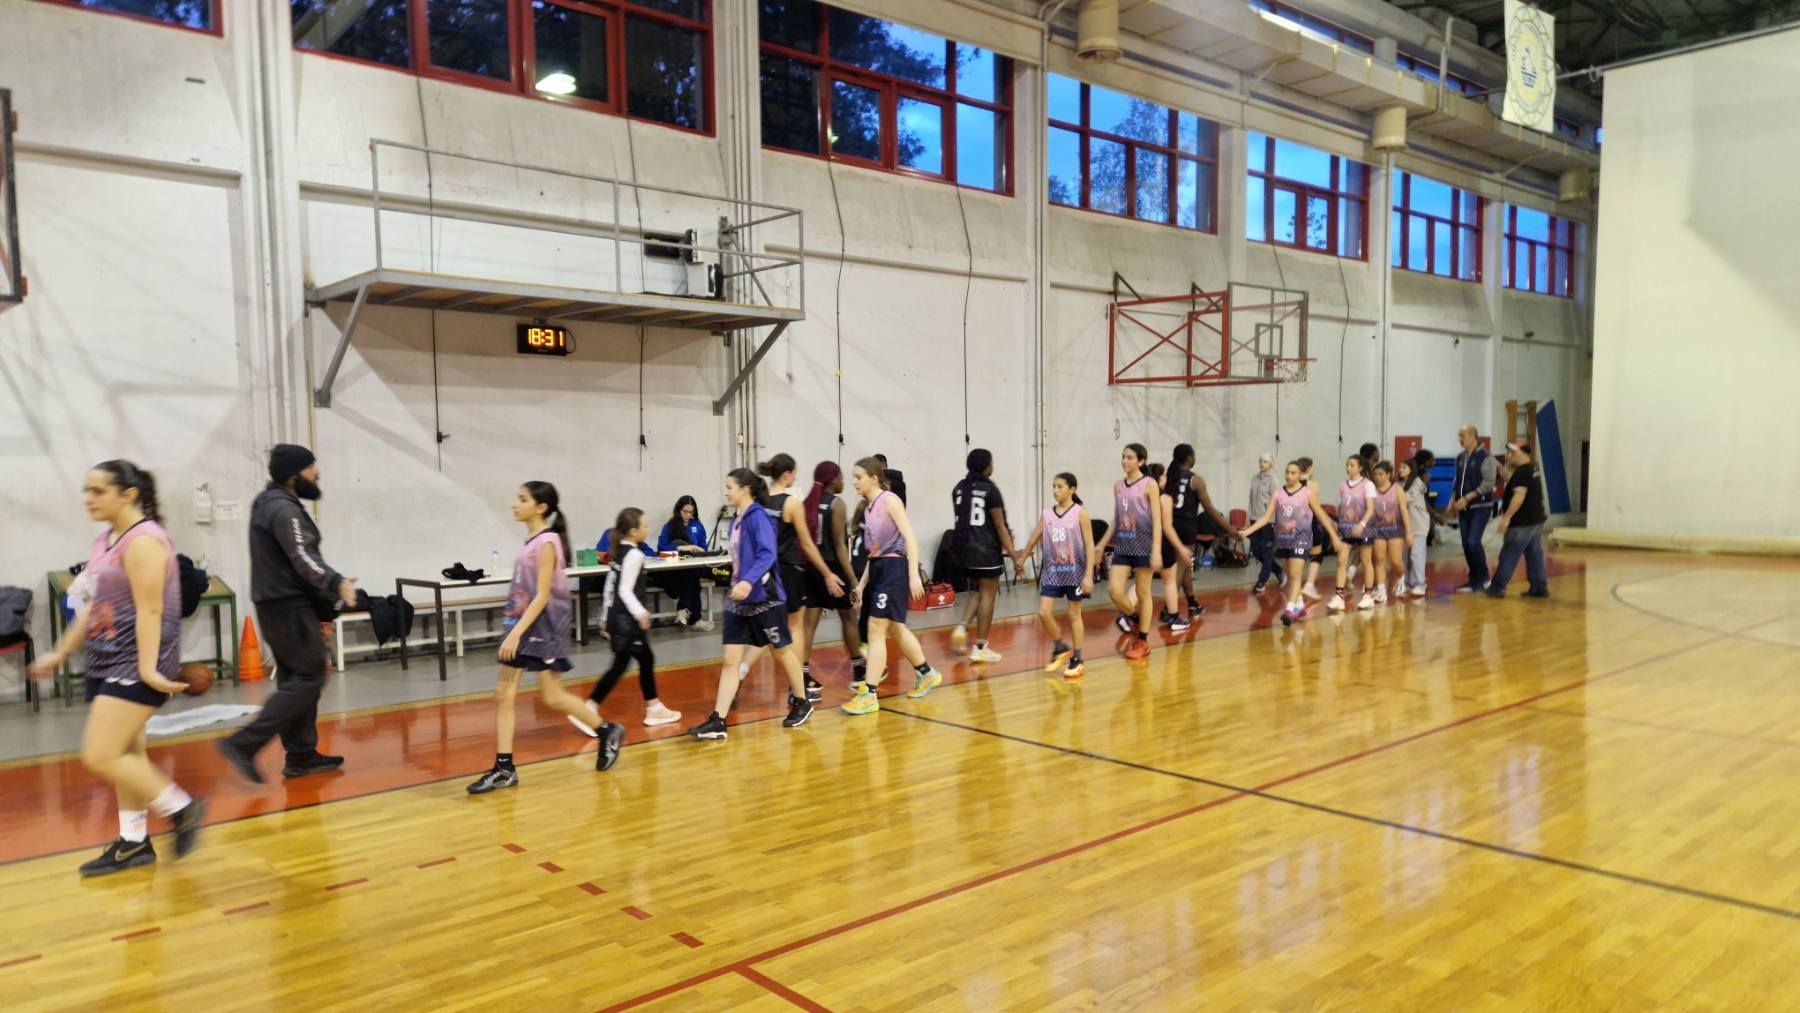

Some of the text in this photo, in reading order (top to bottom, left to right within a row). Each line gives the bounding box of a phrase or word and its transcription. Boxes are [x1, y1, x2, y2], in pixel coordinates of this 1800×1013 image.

[528, 328, 564, 346] 18:31
[1122, 497, 1129, 511] 4
[1051, 527, 1066, 542] 28
[876, 593, 888, 609] 3
